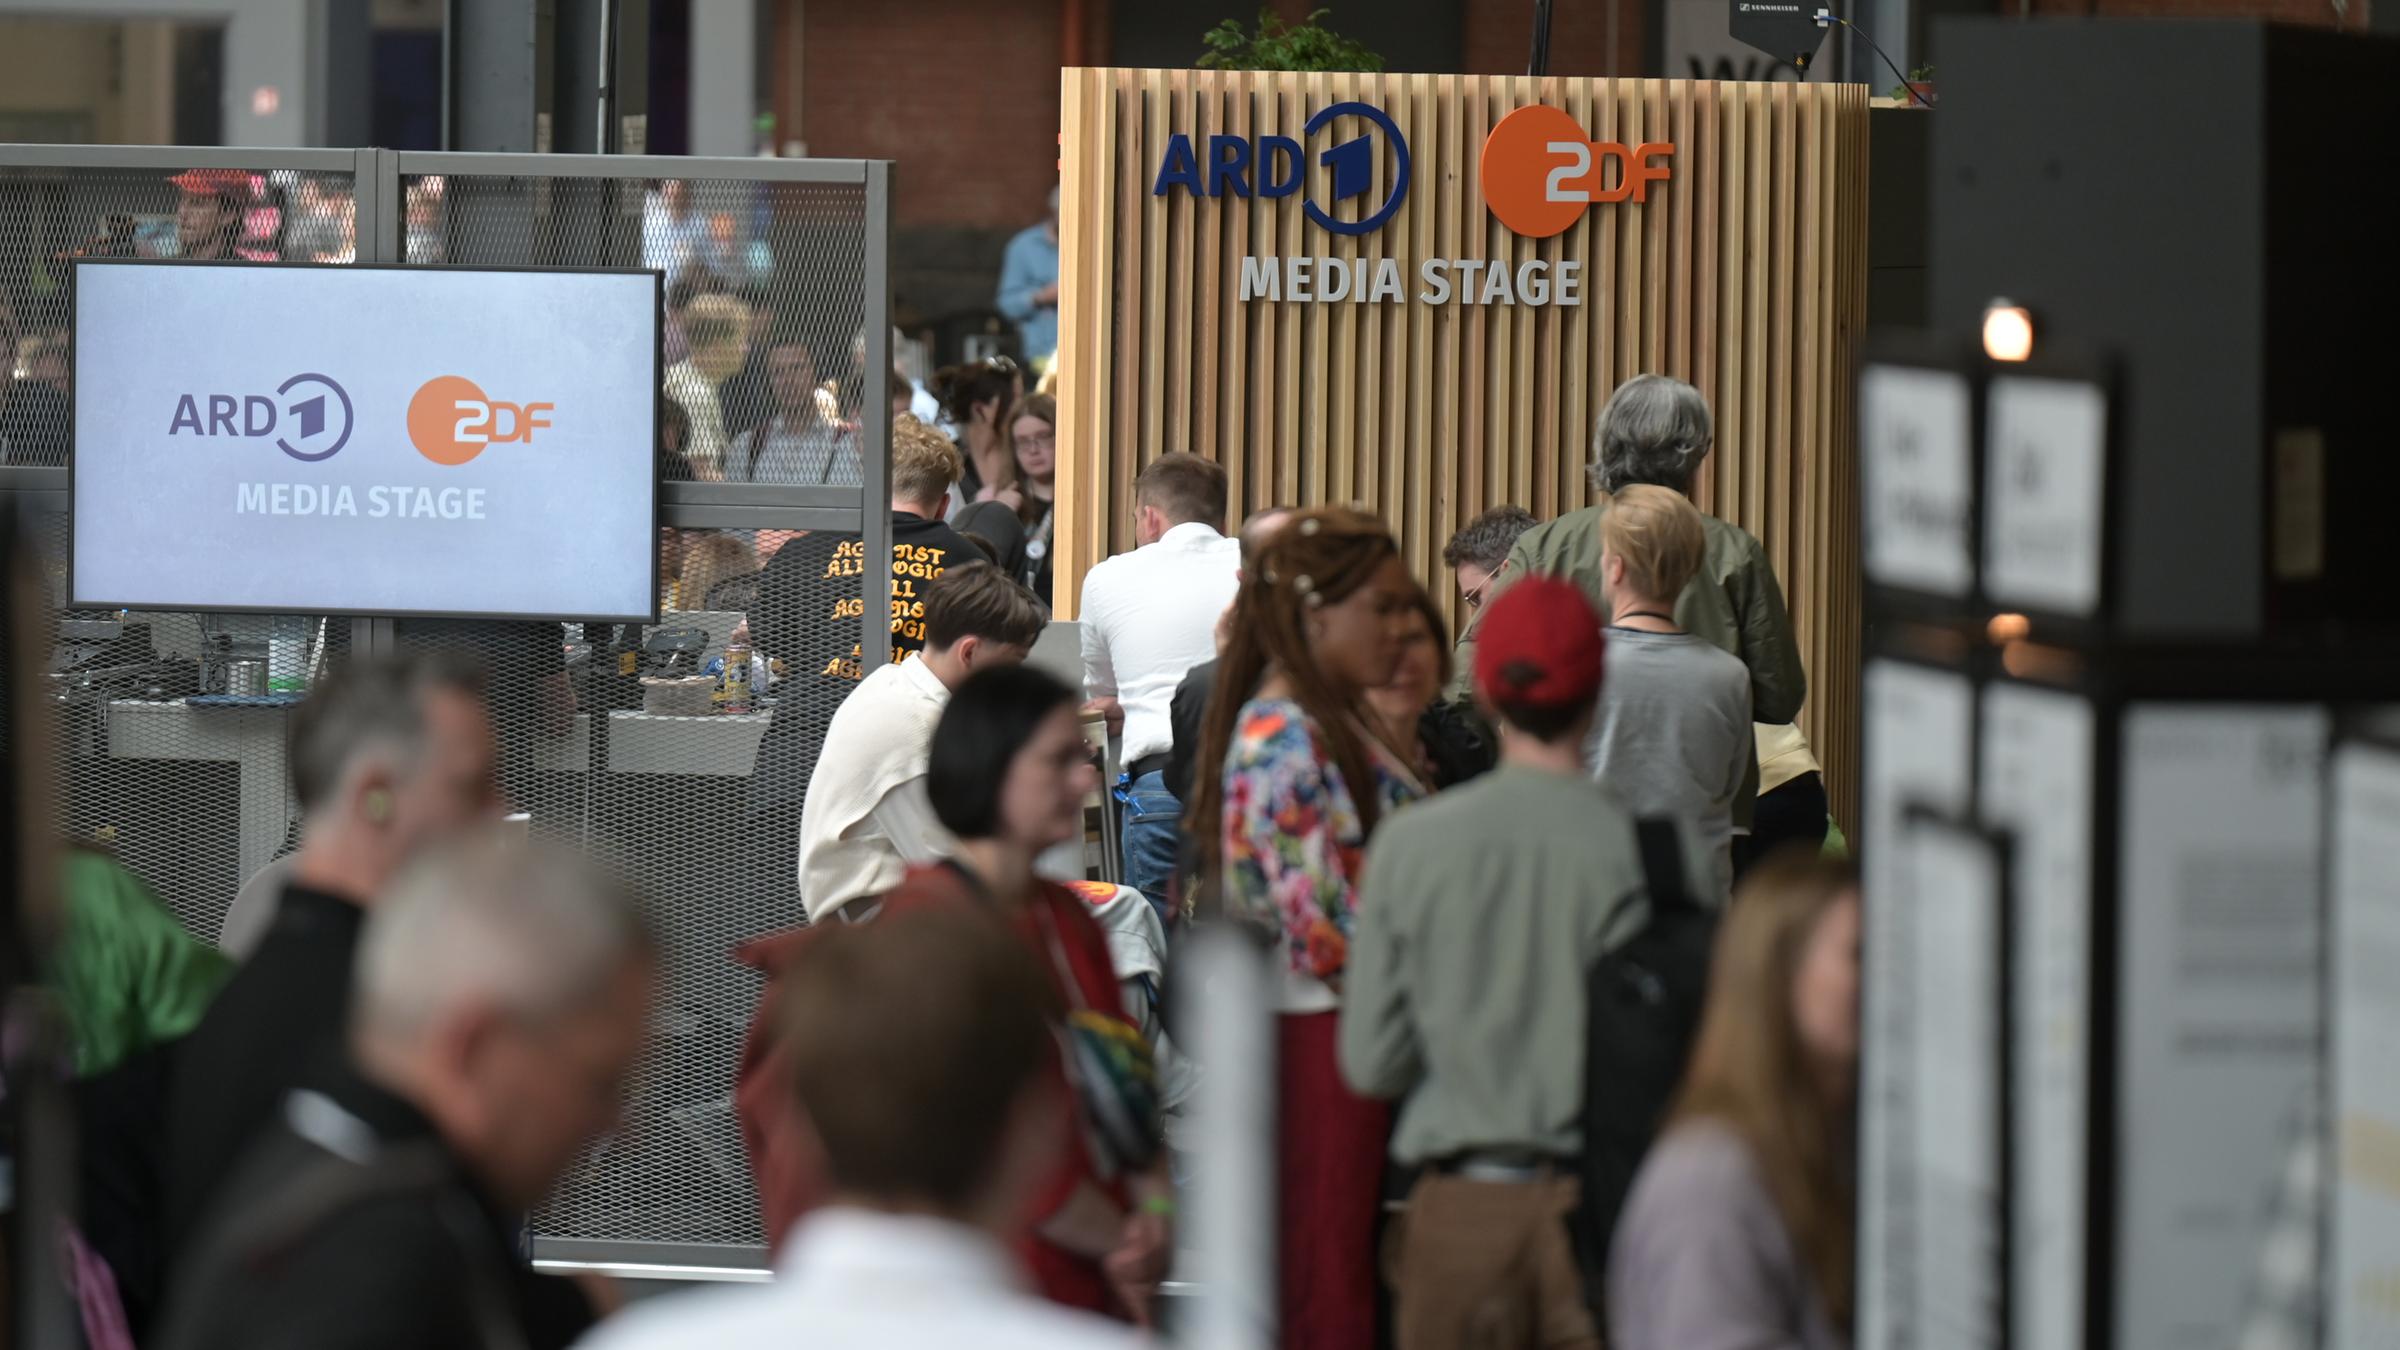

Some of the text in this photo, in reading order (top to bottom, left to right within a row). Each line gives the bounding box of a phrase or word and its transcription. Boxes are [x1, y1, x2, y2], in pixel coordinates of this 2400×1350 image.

[1154, 134, 1305, 197] ARD
[1239, 256, 1582, 306] MEDIA STAGE
[169, 394, 277, 437] ARD
[236, 483, 486, 519] MEDIA STAGE
[832, 541, 946, 564] AGNST
[831, 599, 926, 620] AGNS
